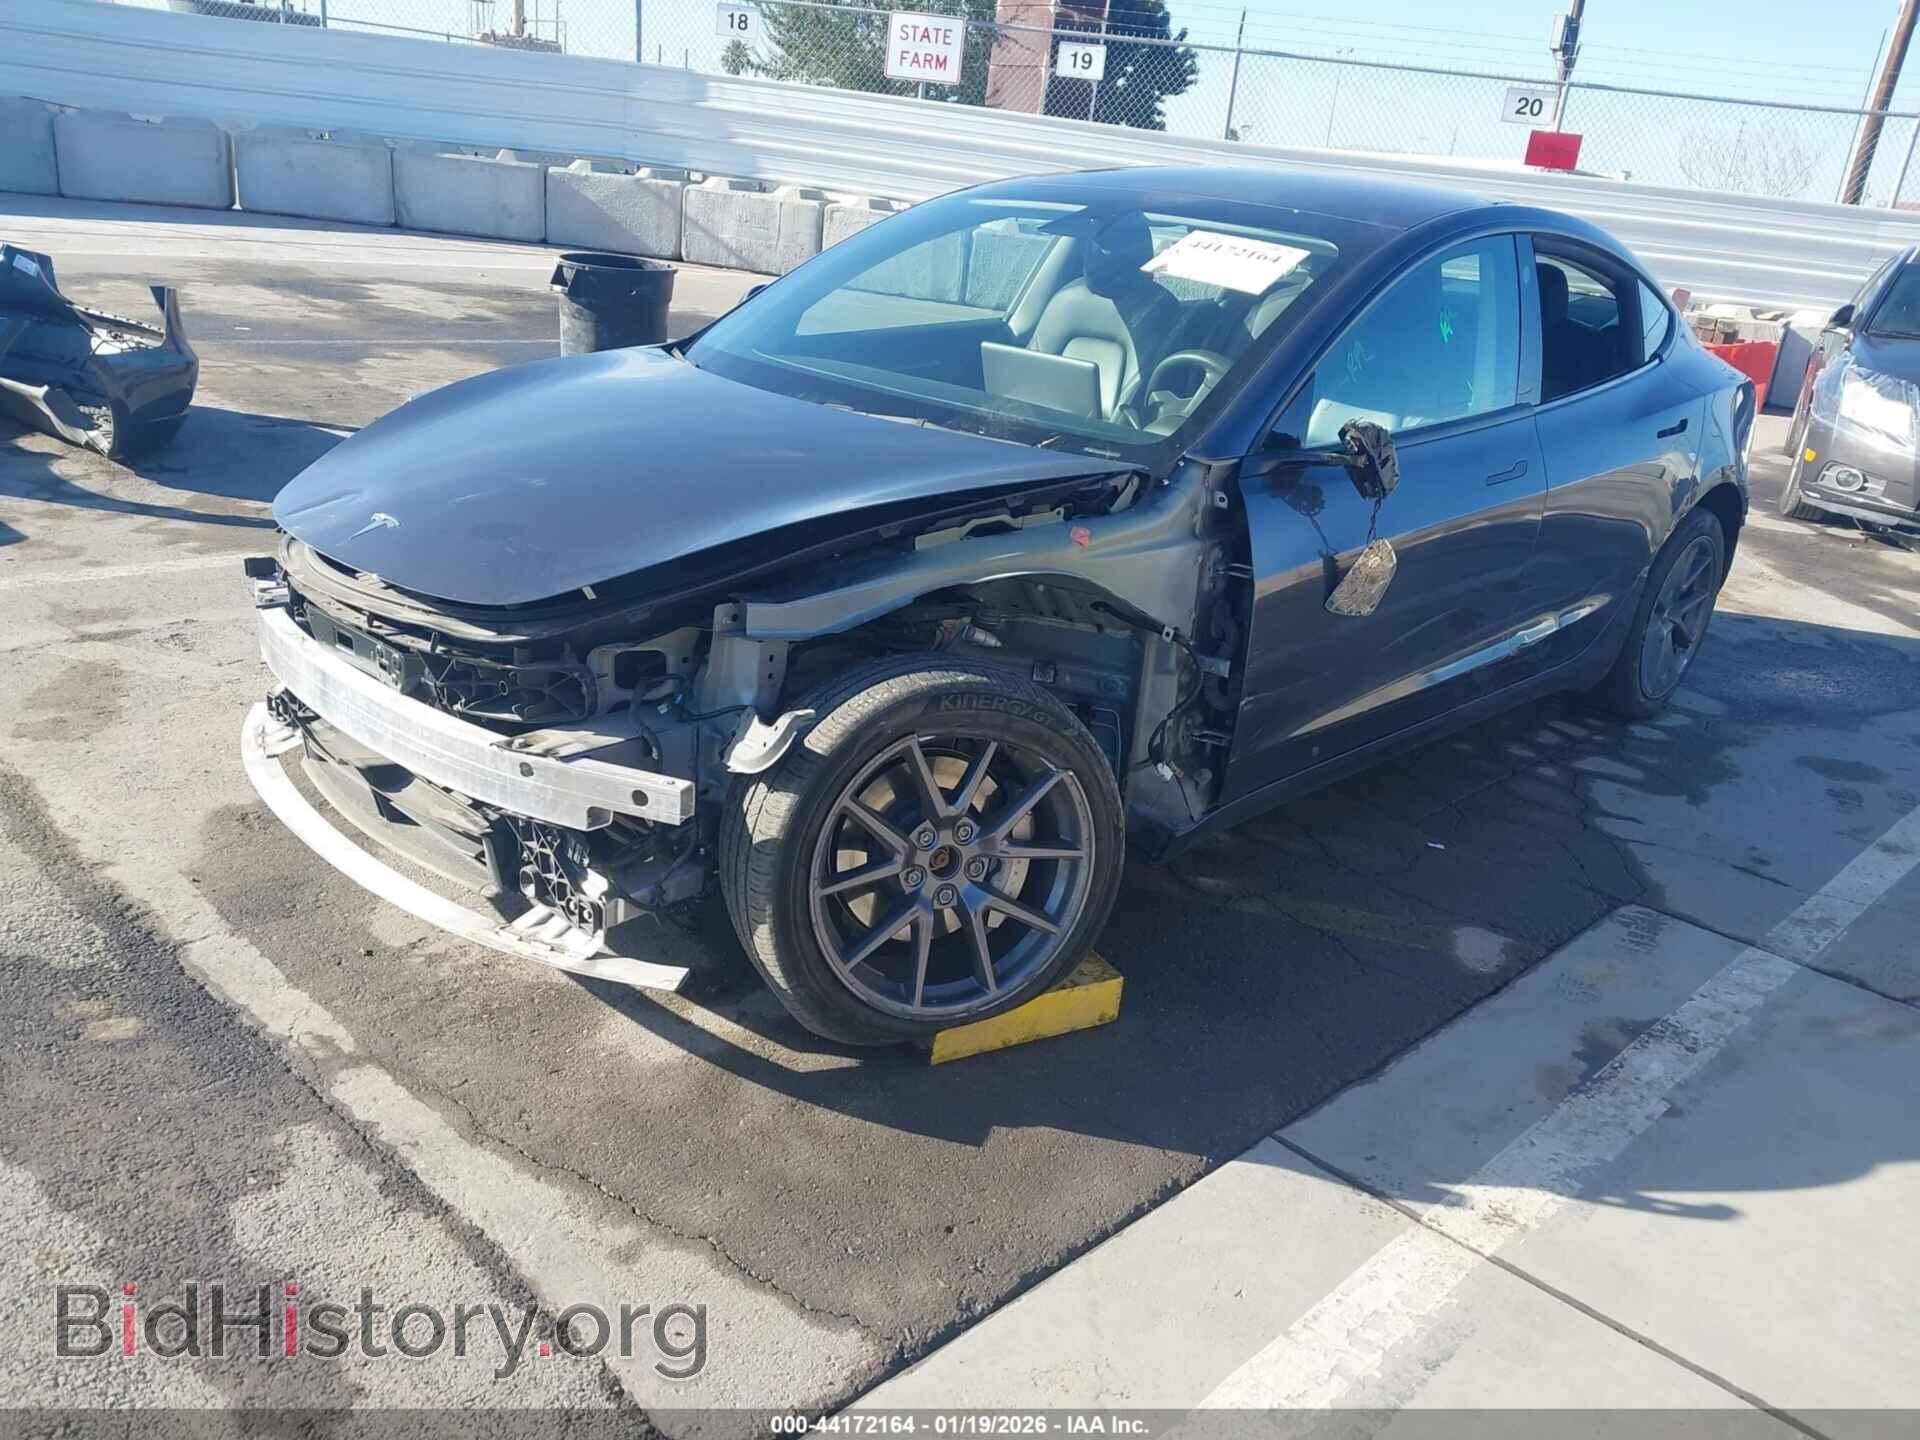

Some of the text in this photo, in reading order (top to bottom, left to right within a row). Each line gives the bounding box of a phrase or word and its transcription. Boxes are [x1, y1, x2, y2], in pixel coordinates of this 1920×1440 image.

[727, 12, 749, 31] 18
[899, 24, 953, 47] STATE
[899, 50, 949, 72] FARM
[1070, 51, 1094, 71] 19
[1515, 97, 1543, 117] 20
